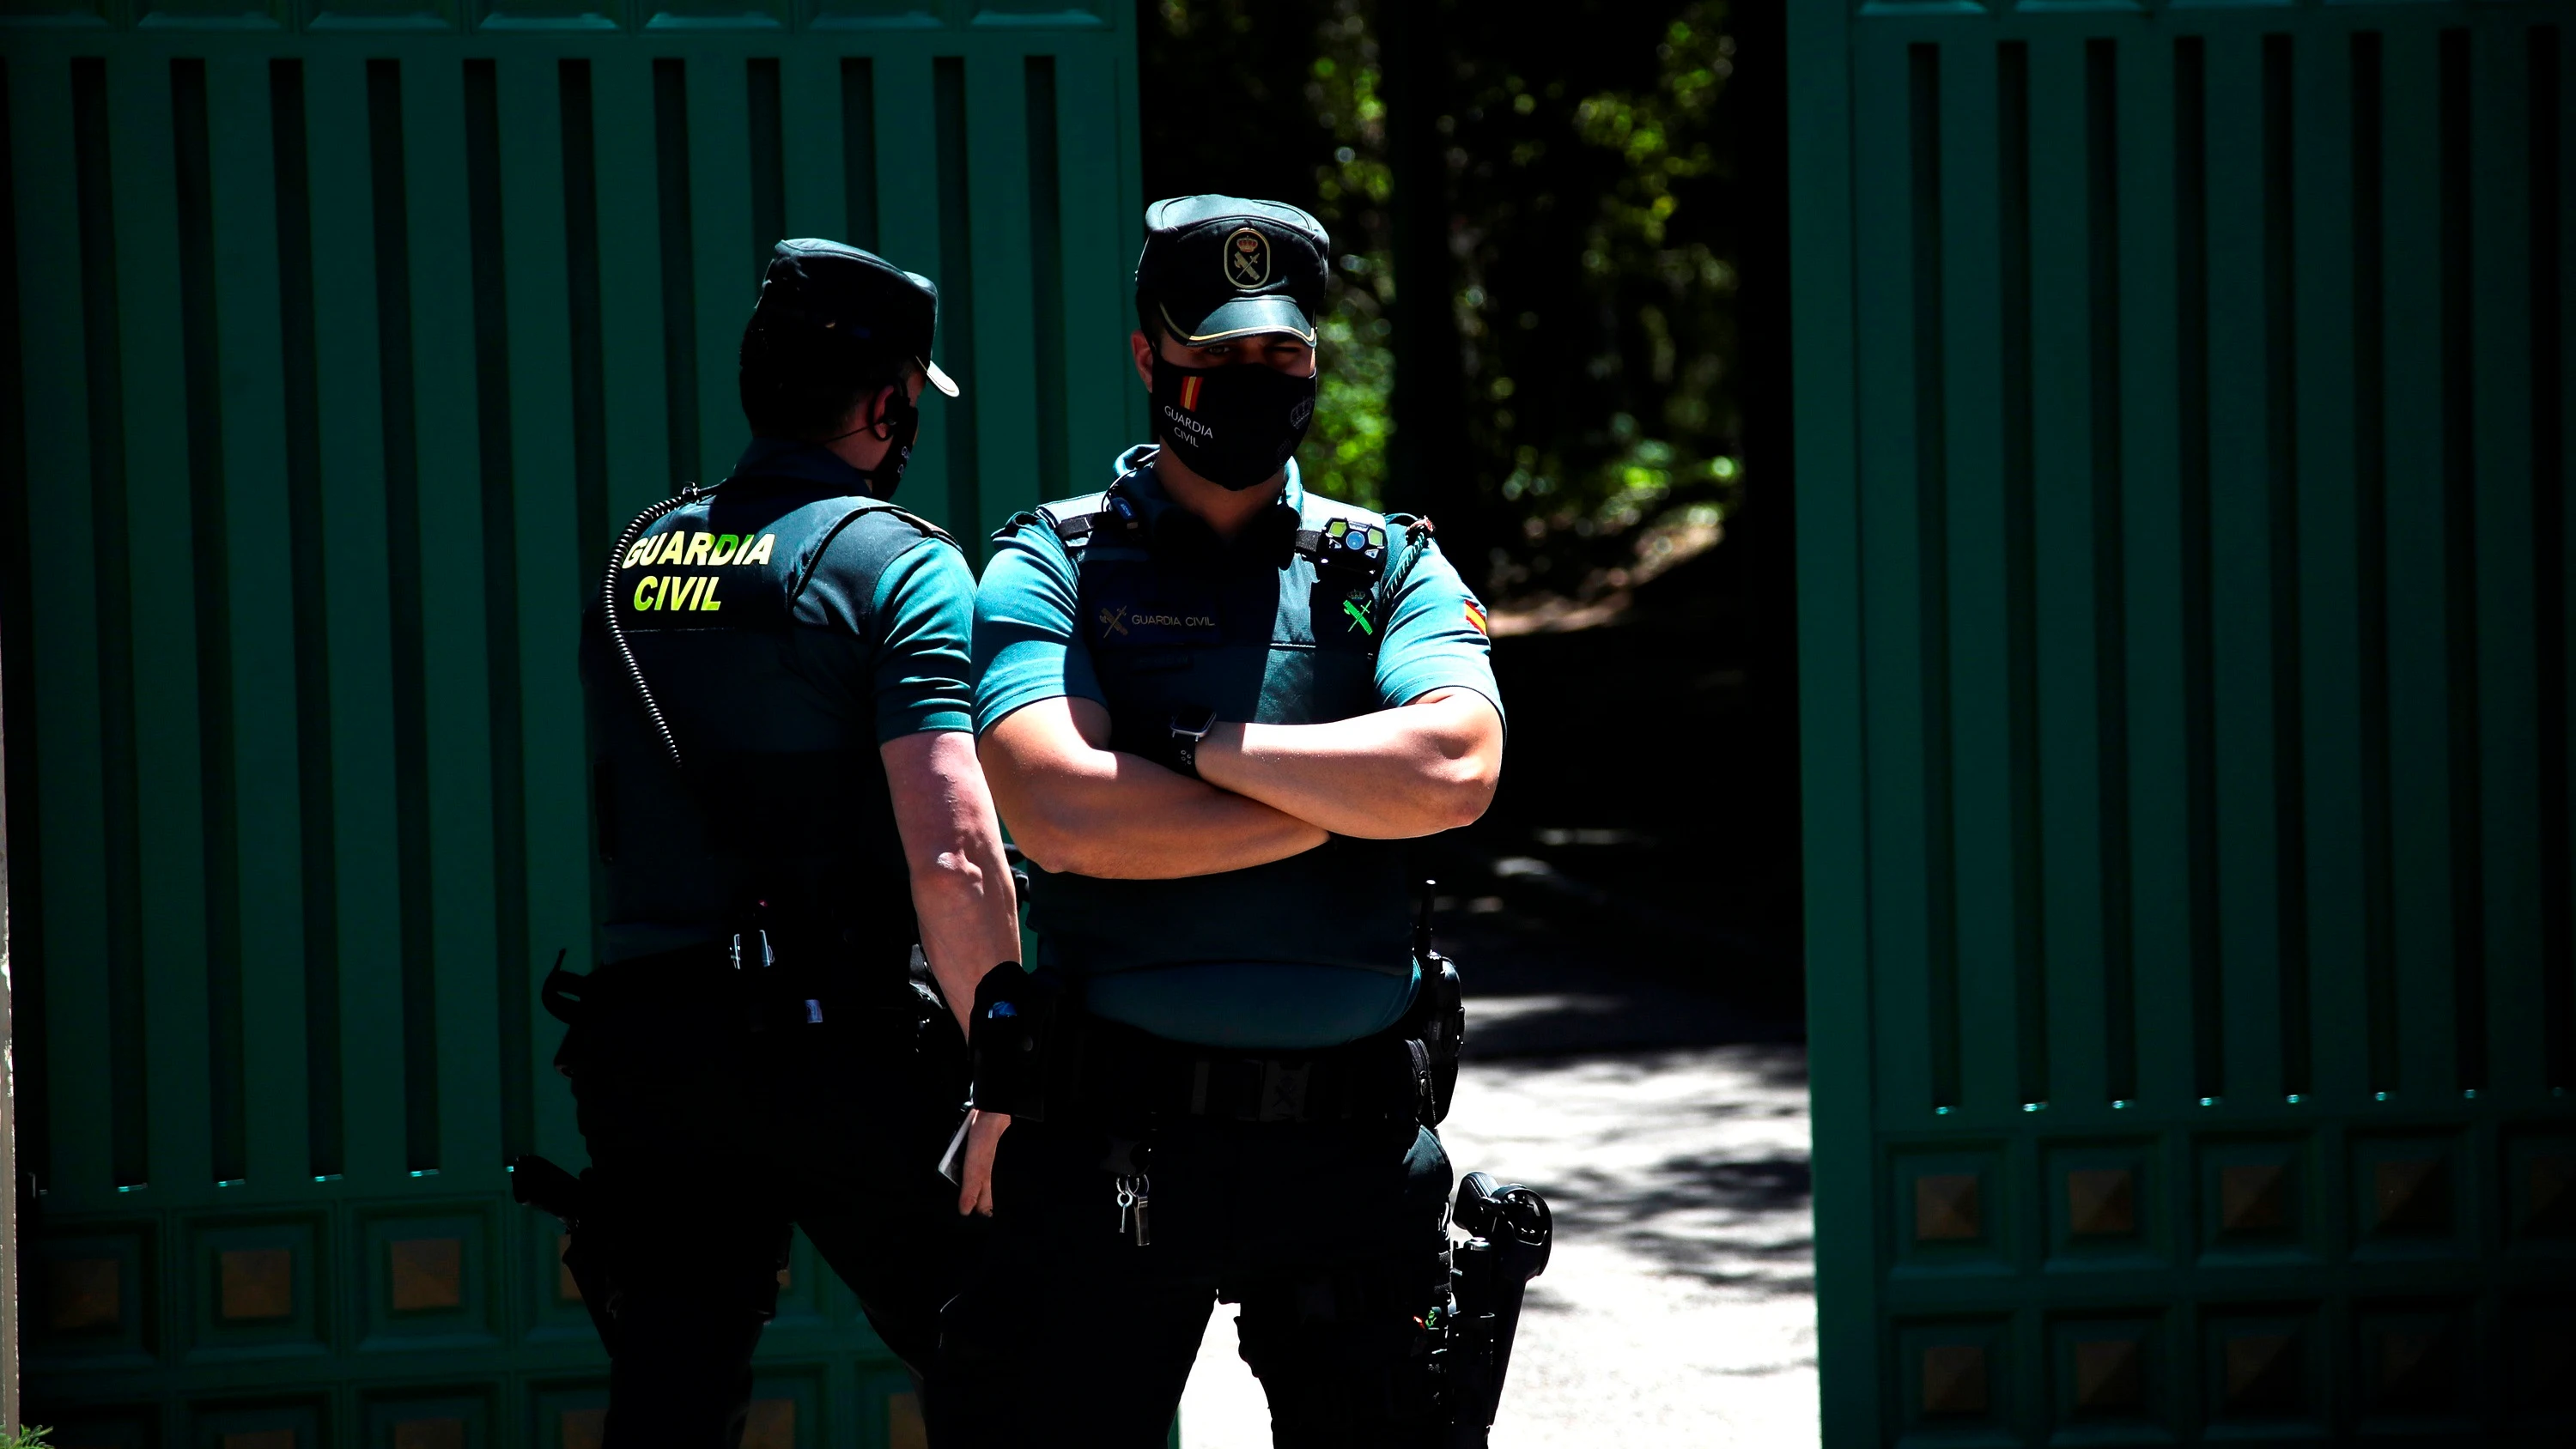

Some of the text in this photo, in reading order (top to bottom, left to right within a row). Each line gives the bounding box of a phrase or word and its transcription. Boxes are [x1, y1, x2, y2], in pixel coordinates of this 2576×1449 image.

[1163, 405, 1214, 439] GUARDIA
[1173, 427, 1200, 448] CIVIL
[621, 530, 776, 569] GUARDIA
[633, 575, 722, 611] CIVIL
[1131, 615, 1216, 627] GUARDIA CIVIL
